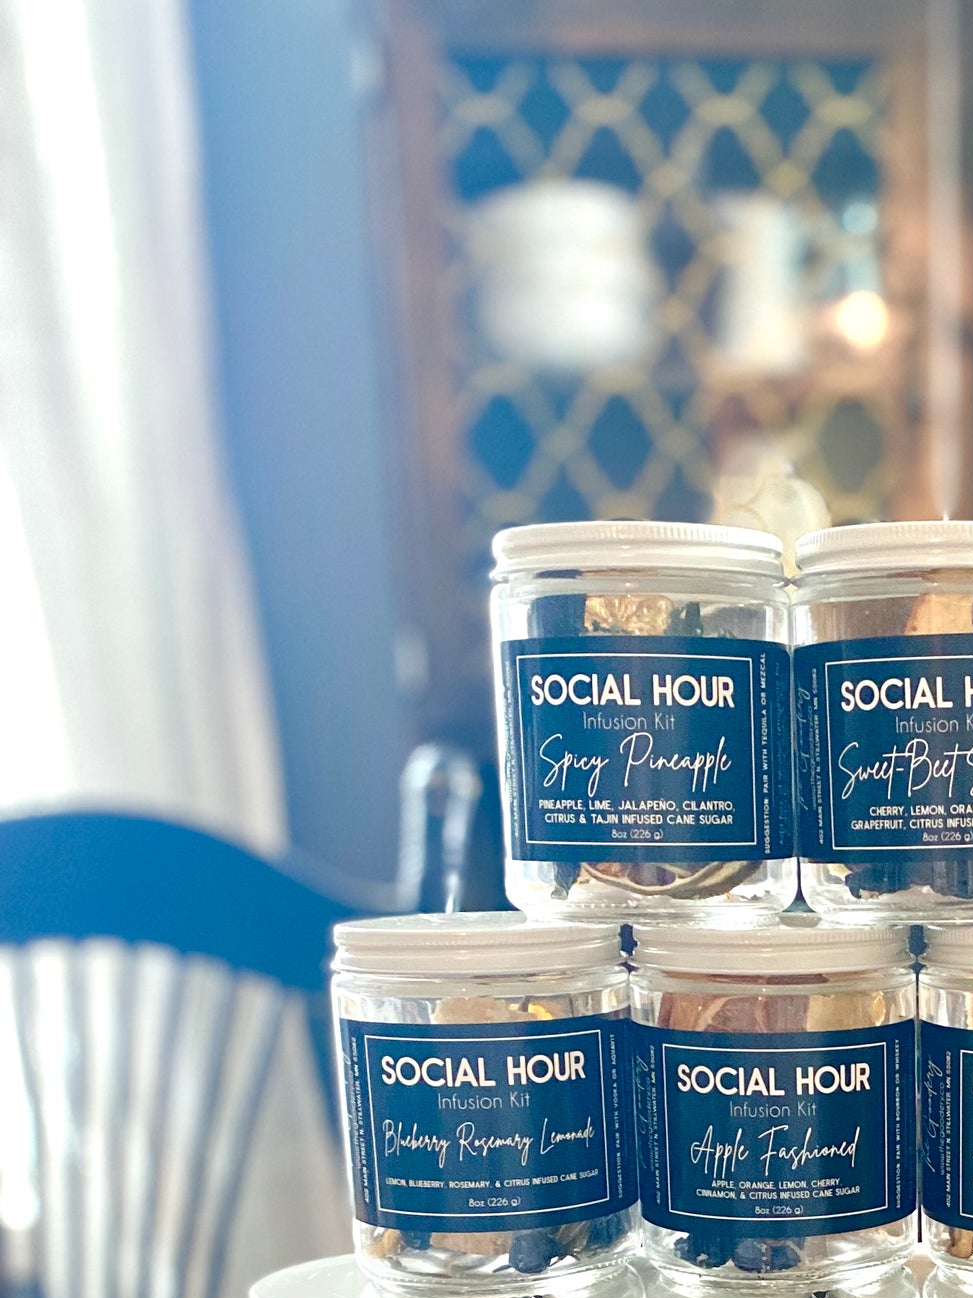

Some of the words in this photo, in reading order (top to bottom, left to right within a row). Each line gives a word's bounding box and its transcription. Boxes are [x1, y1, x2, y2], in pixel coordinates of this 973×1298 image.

[531, 674, 641, 706] SOCIAL
[652, 675, 735, 708] HOUR
[840, 676, 953, 712] SOCIAL
[583, 713, 647, 730] Infusion
[655, 713, 676, 729] Kit
[895, 716, 959, 734] Infusion
[539, 733, 609, 797] Spicy
[620, 732, 732, 792] Pineapple
[618, 798, 679, 811] JALAPEÑO,
[683, 800, 736, 811] CILANTRO,
[911, 806, 947, 816] LEMON,
[545, 814, 575, 823] CITRUS
[579, 815, 586, 823] &
[622, 815, 663, 824] INFUSED
[666, 815, 695, 824] CANE
[699, 815, 733, 824] SUGAR
[381, 1055, 496, 1087] SOCIAL
[507, 1050, 586, 1086] HOUR
[677, 1063, 785, 1097] SOCIAL
[796, 1062, 871, 1095] HOUR
[438, 1093, 503, 1110] Infusion
[510, 1092, 531, 1108] Kit
[730, 1101, 791, 1118] Infusion
[797, 1102, 817, 1116] Kit
[382, 1119, 450, 1168] Blueberry
[457, 1122, 534, 1166] Rosemary
[540, 1116, 595, 1155] Lemonade
[690, 1125, 749, 1178] Apple
[758, 1125, 860, 1176] Fashioned
